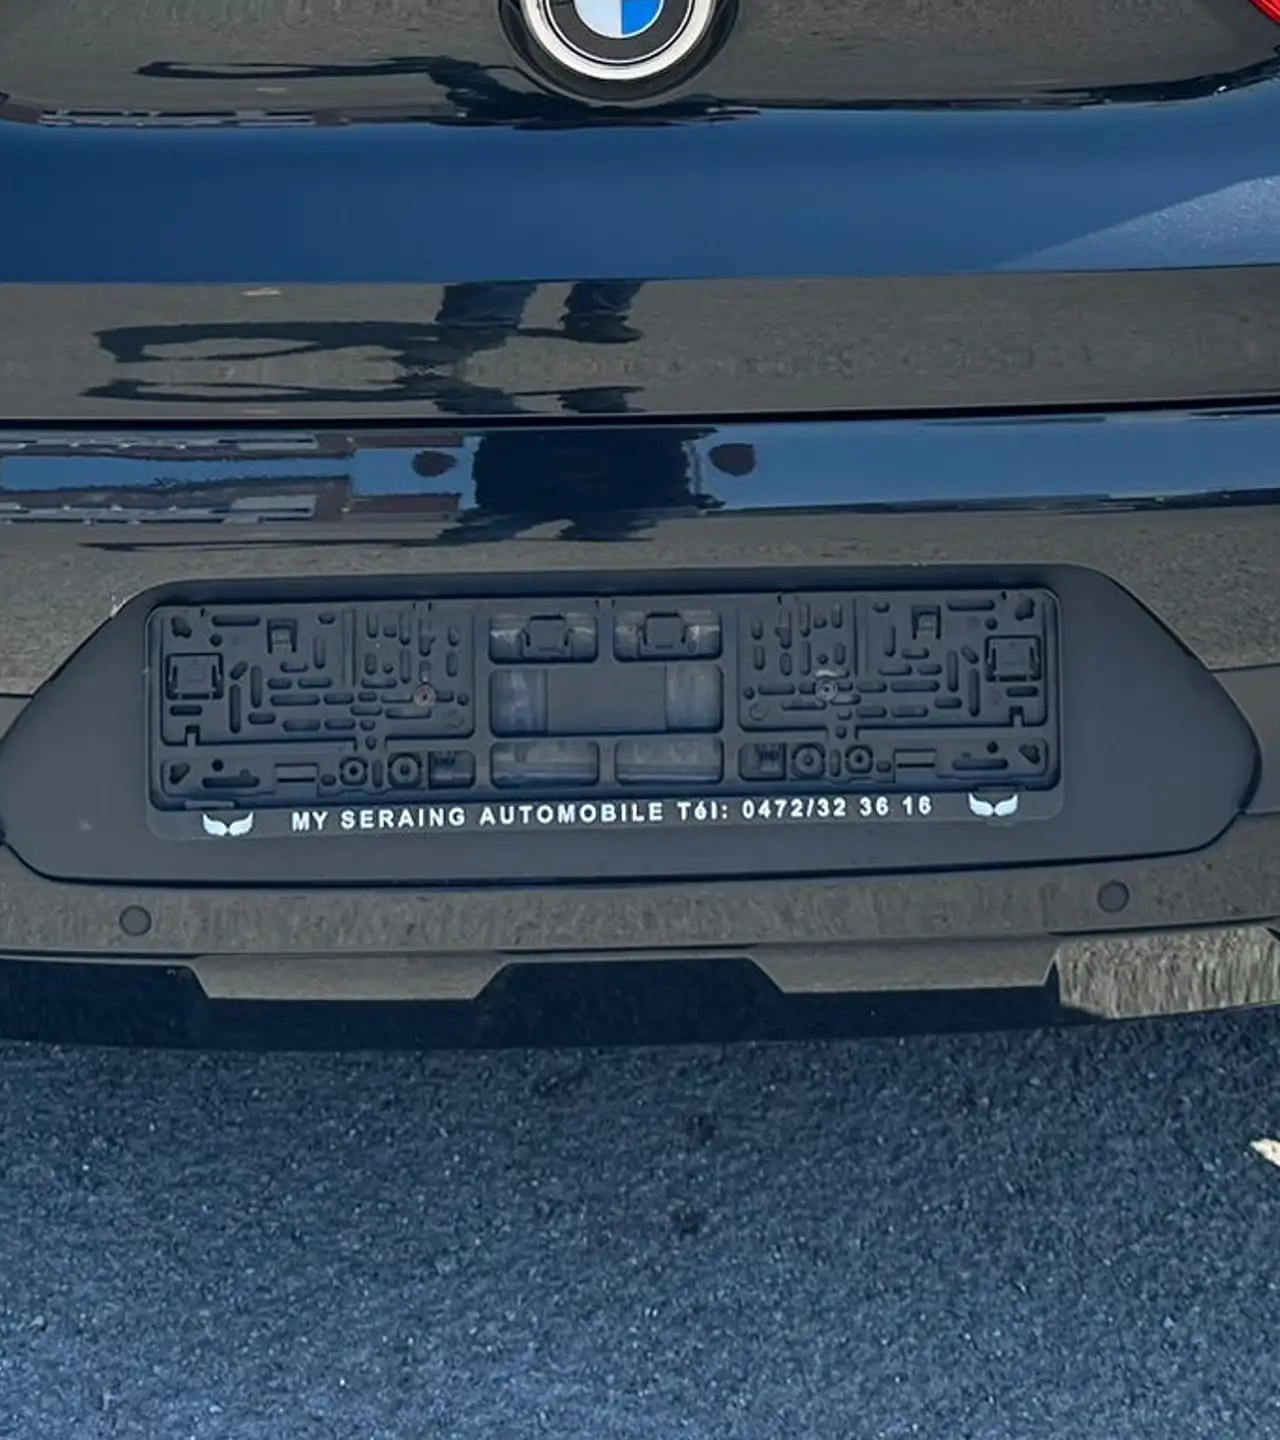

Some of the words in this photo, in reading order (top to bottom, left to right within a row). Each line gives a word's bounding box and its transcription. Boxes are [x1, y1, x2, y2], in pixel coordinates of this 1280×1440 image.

[292, 811, 328, 832] MY
[340, 807, 466, 830] SERAING
[479, 801, 664, 826] AUTOMOBILE
[741, 796, 846, 820] 0472/32
[858, 795, 889, 817] 36
[901, 794, 932, 816] 16
